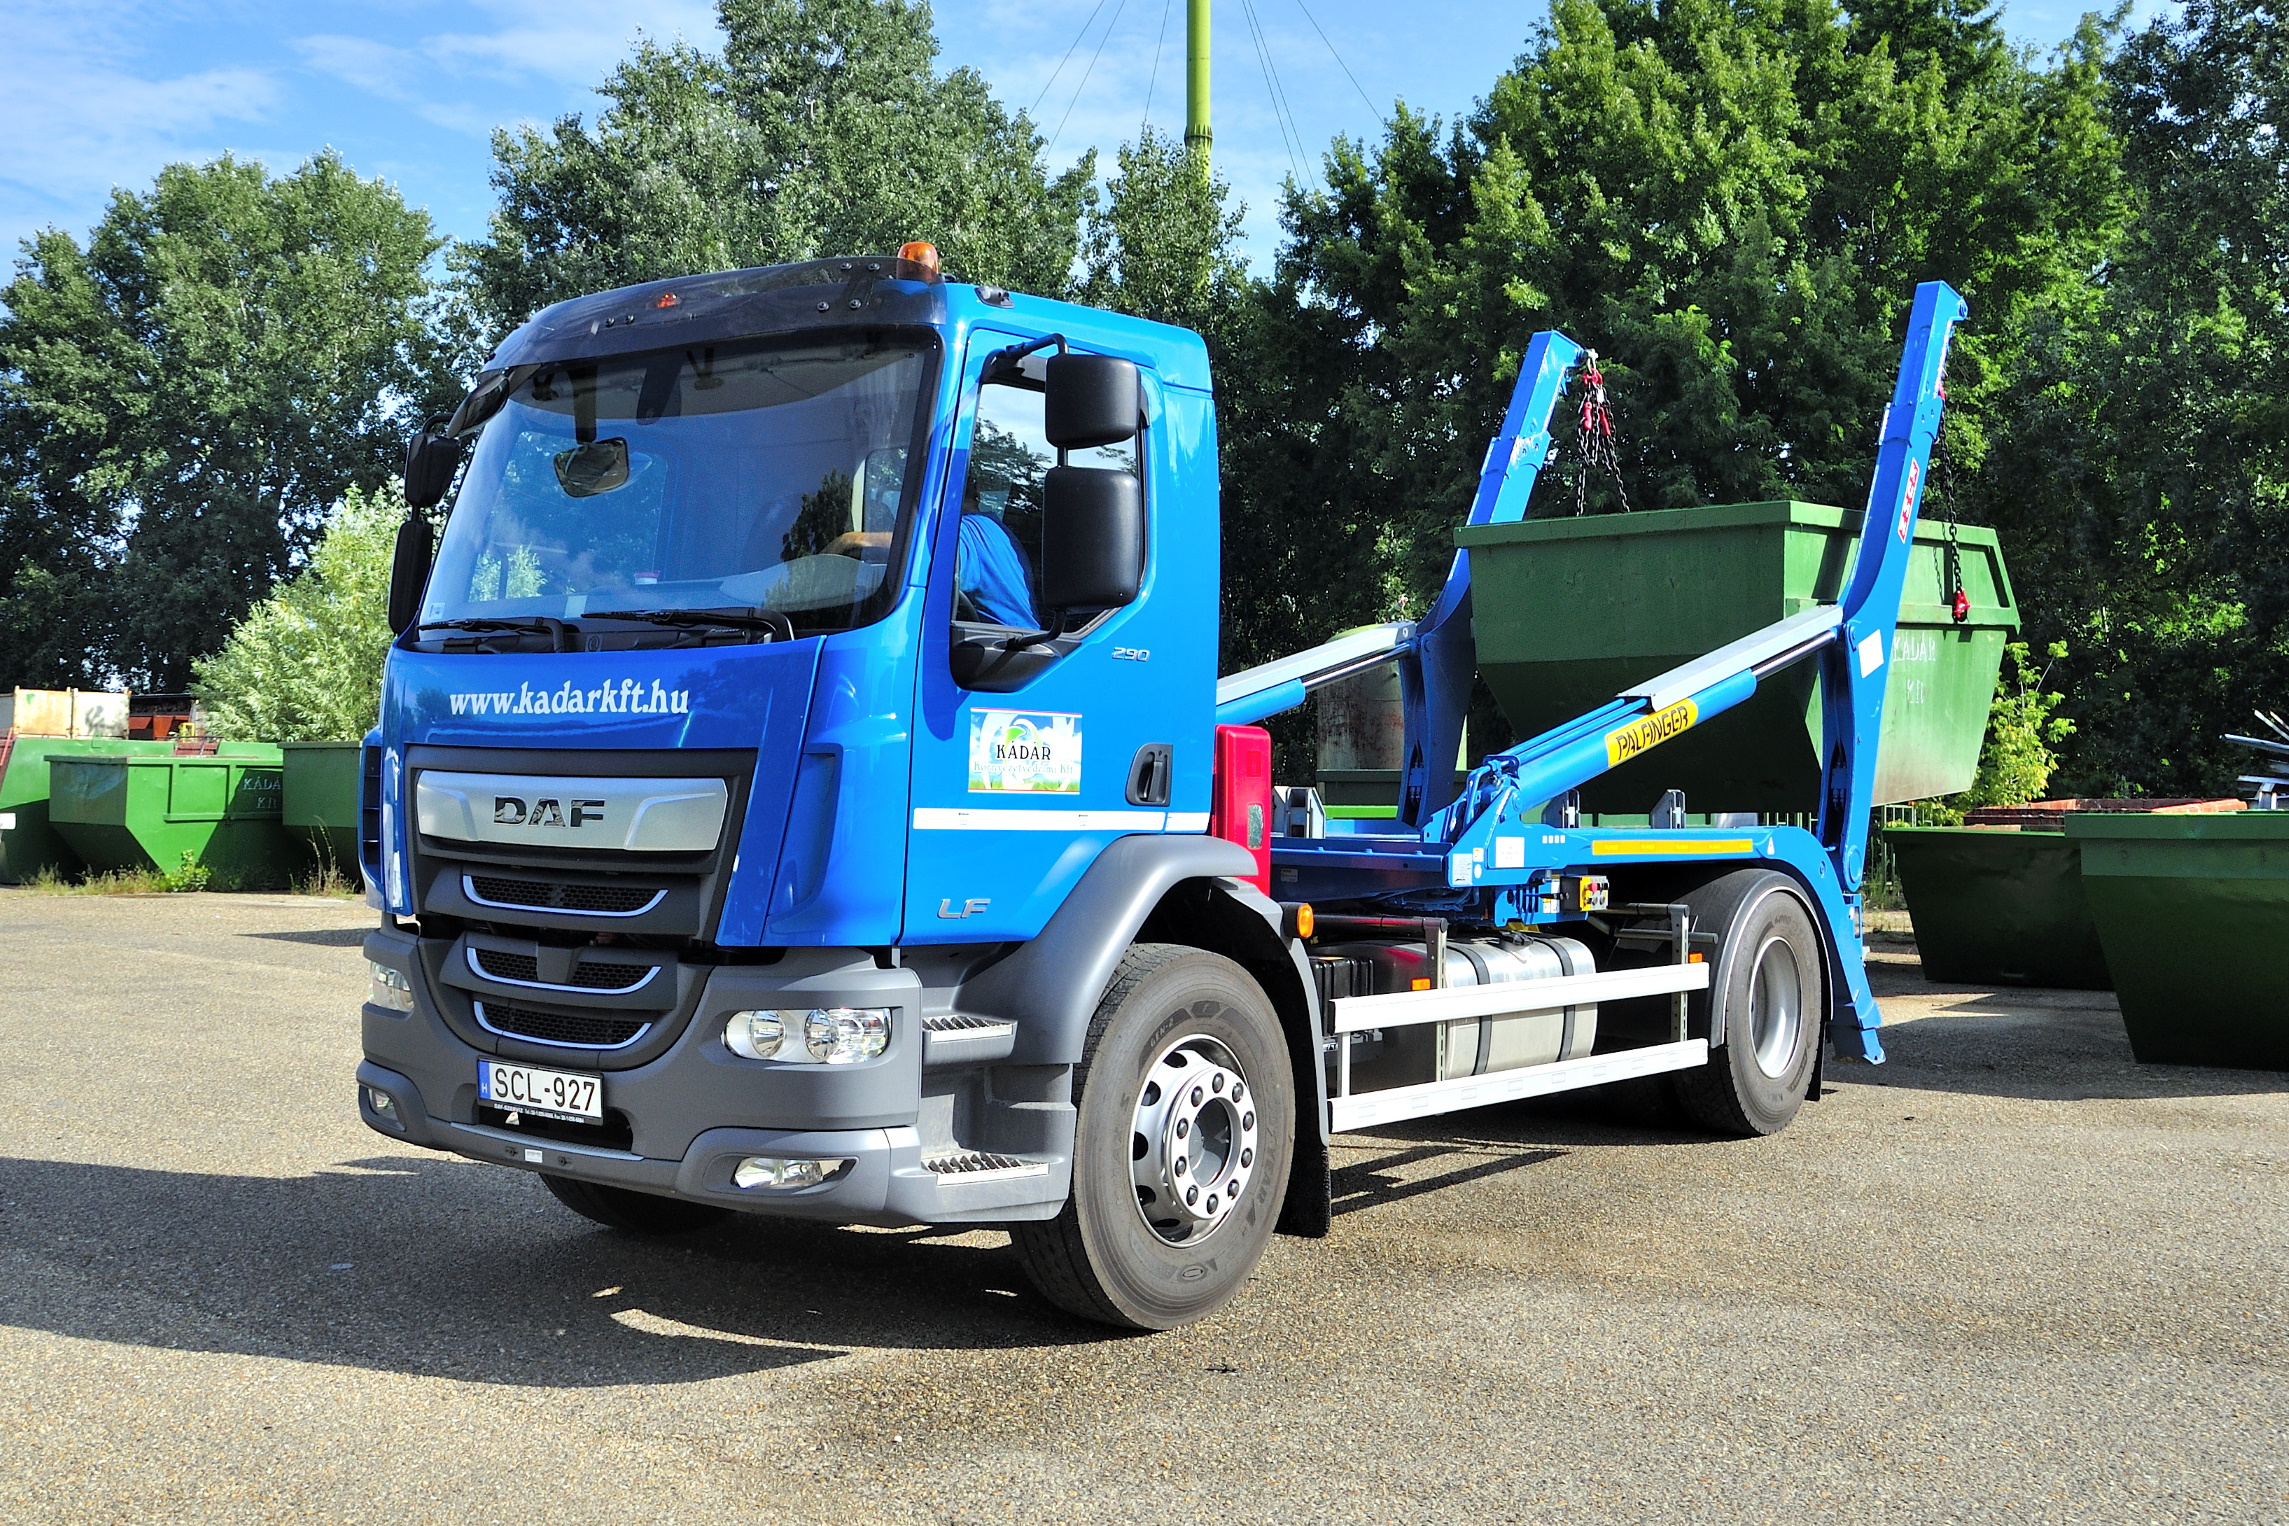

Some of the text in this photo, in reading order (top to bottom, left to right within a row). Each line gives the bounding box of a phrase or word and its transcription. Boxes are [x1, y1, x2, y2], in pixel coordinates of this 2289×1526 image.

[1112, 647, 1150, 662] 290
[450, 678, 689, 715] www.kadarkft.hu
[1615, 706, 1688, 761] PALFINGER
[996, 741, 1051, 760] KÁDÁR
[242, 776, 281, 791] KÁDÁ
[493, 795, 606, 828] DAF
[937, 898, 991, 919] LF
[482, 1083, 488, 1094] H
[495, 1068, 595, 1111] SCL-927
